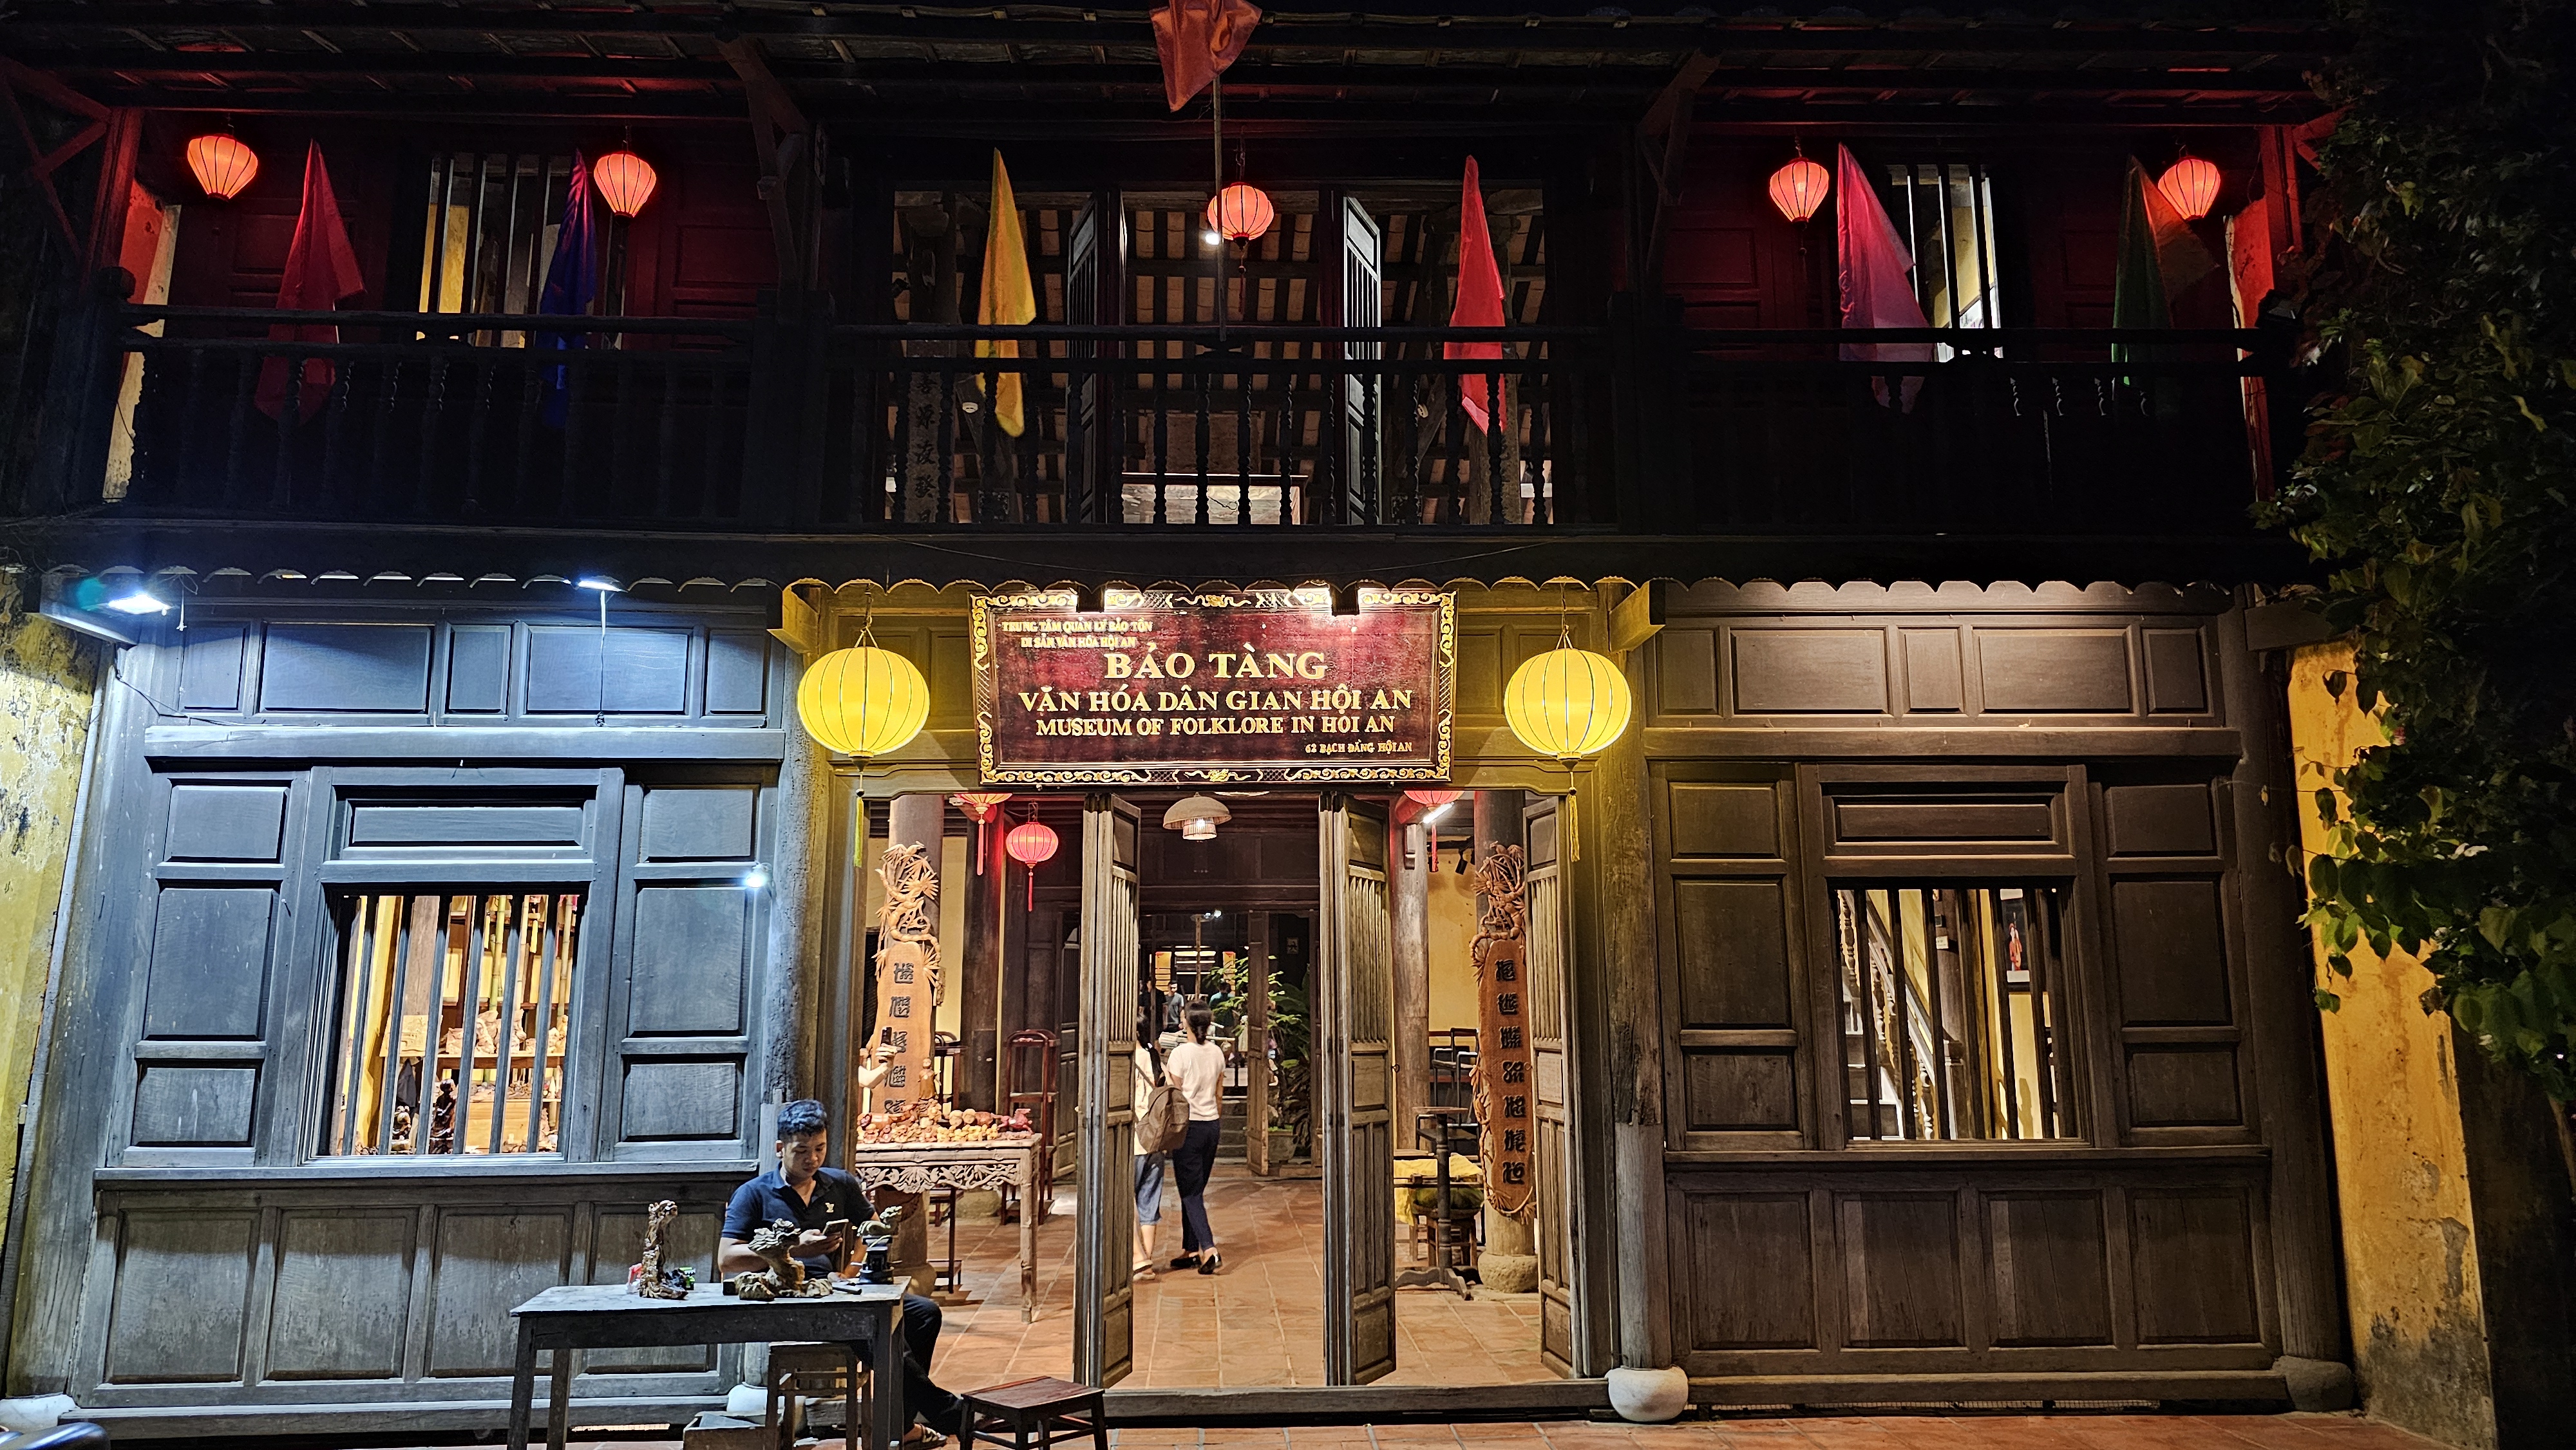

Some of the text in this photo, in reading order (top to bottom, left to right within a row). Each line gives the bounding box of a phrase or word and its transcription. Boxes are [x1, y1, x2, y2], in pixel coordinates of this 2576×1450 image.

[1001, 621, 1038, 632] TRUNG
[1038, 618, 1063, 632] TÂM
[1021, 637, 1032, 648] DI
[1100, 634, 1119, 650] HỘI
[1120, 636, 1137, 648] AN
[1104, 641, 1329, 679] BẢO TÀNG
[1018, 683, 1413, 715] VĂN HÓA DÂN GIAN HỘI AN
[1036, 715, 1396, 737] MUSEUM OF FOLKLORE IN HOI AN
[1305, 743, 1317, 753] 62
[1319, 743, 1345, 755] BẠCH
[1377, 739, 1397, 755] HỘI
[1397, 742, 1412, 752] AN
